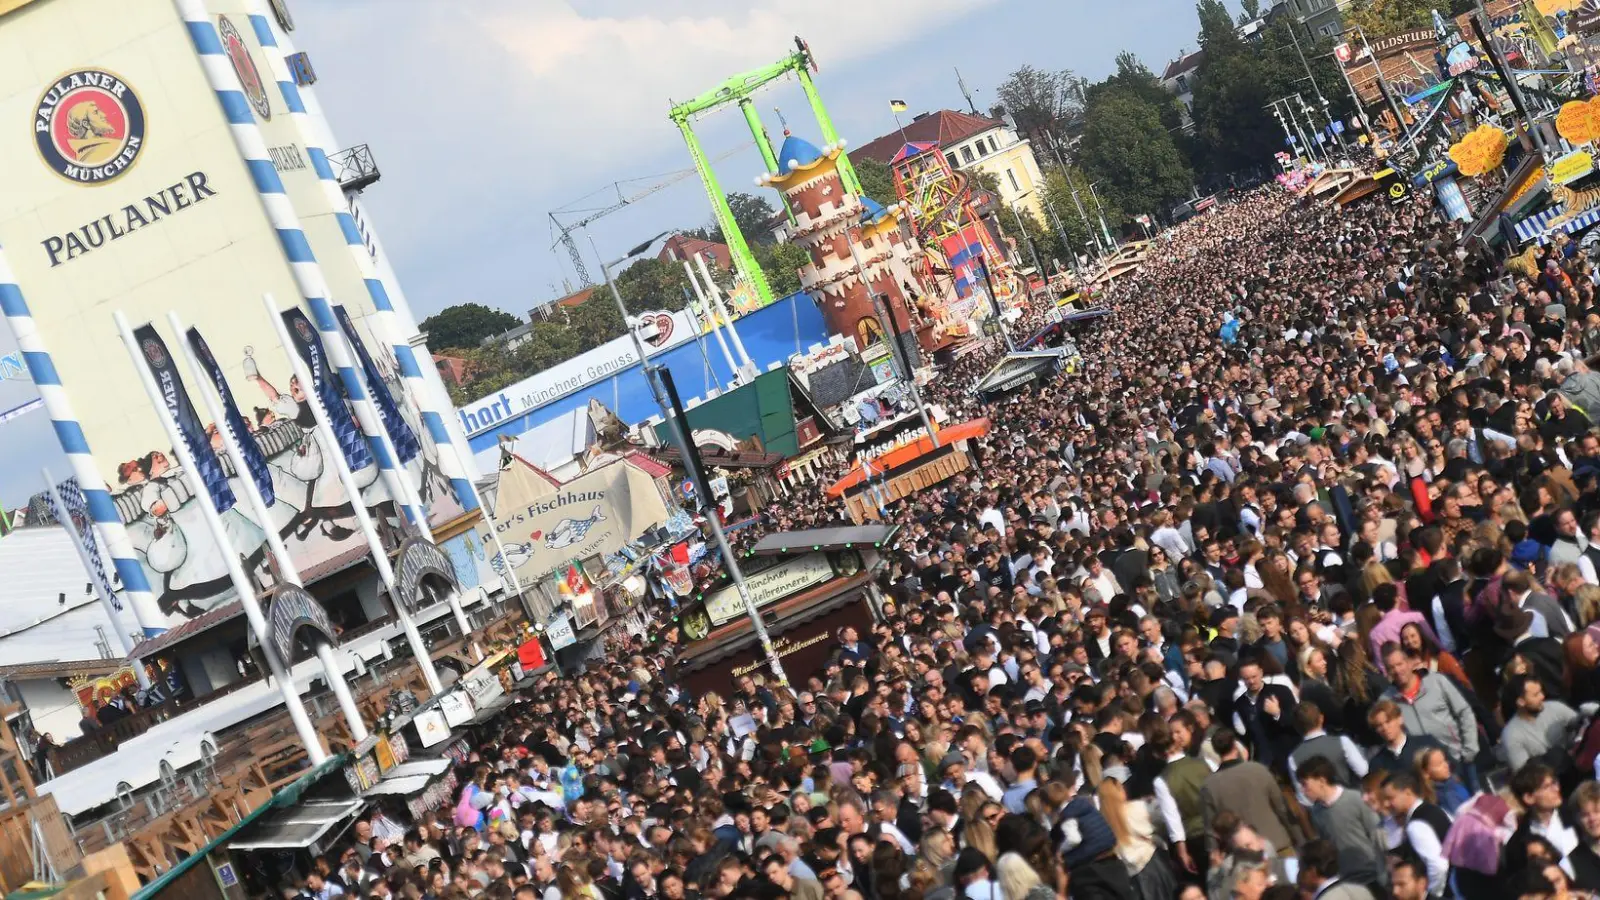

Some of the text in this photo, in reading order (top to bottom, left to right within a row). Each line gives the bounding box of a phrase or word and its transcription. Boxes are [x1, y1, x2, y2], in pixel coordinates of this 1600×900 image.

[36, 72, 126, 133] PAULANER
[64, 136, 140, 181] MÜNCHEN
[40, 171, 217, 268] PAULANER
[458, 352, 634, 433] hart Münchner Genuss
[527, 490, 605, 518] Fischhaus
